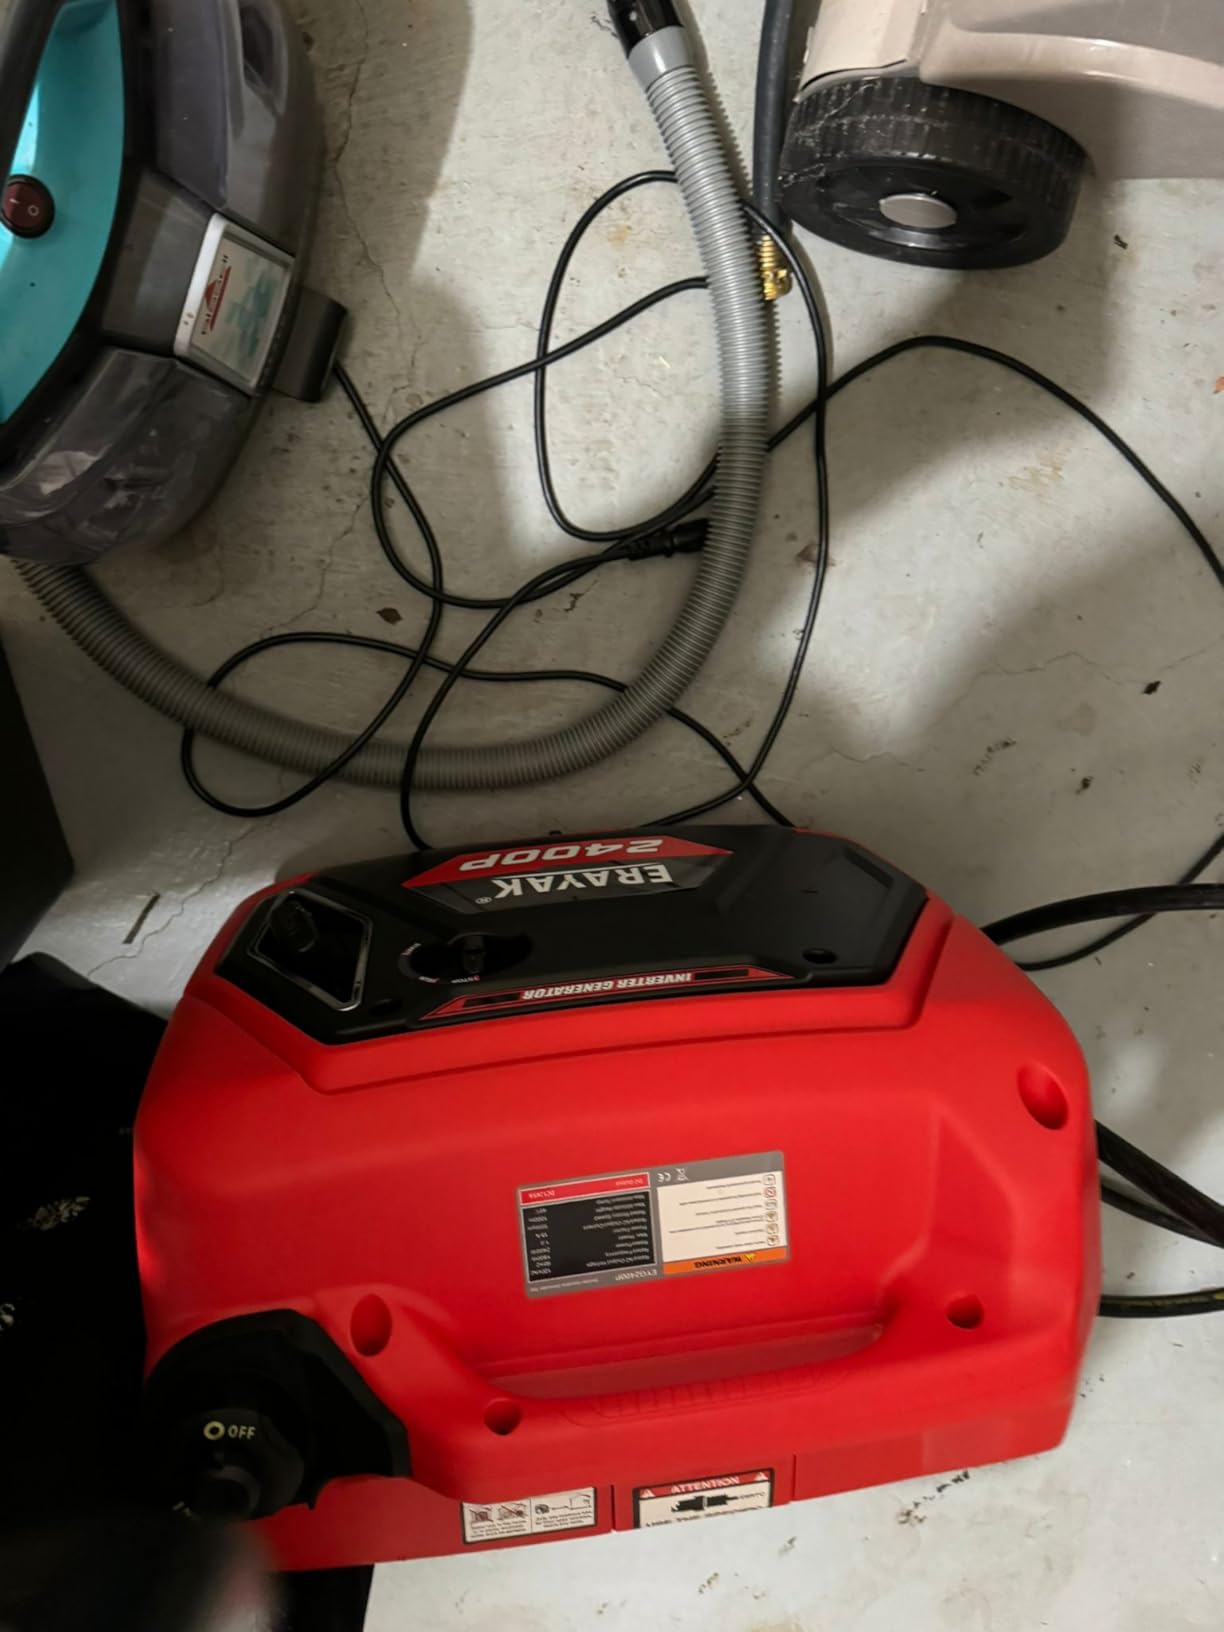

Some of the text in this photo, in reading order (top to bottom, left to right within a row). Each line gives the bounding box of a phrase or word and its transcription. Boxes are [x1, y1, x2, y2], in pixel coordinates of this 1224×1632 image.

[459, 838, 663, 872] 2400P
[490, 863, 673, 900] ERAYAK
[522, 972, 692, 1001] INVERTER GENERATOR
[694, 1255, 742, 1268] WARNING
[227, 1425, 256, 1440] OFF
[669, 1475, 740, 1494] ATTENTION
